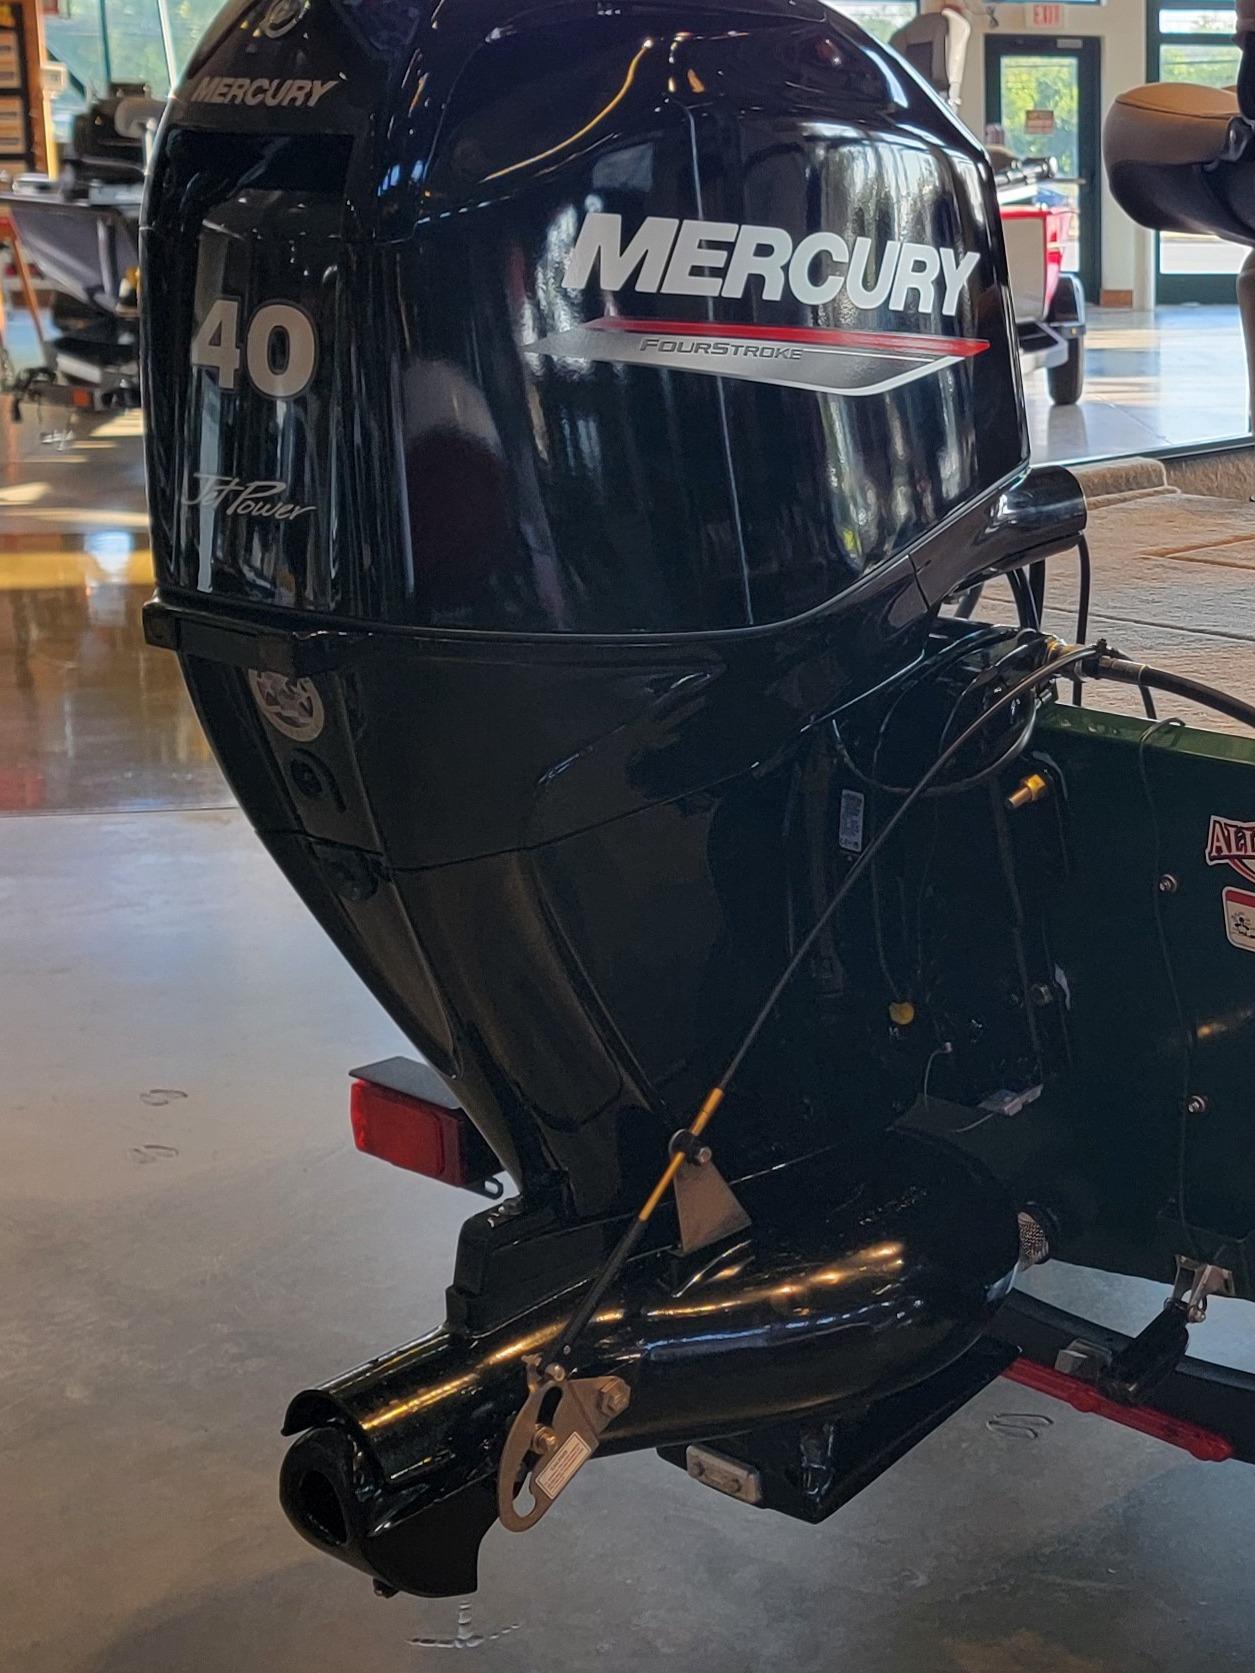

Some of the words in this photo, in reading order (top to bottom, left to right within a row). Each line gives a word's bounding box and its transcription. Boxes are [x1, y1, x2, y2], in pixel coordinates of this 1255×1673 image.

[191, 76, 339, 107] MERCURY
[562, 213, 981, 317] MERCURY
[191, 299, 316, 398] 40
